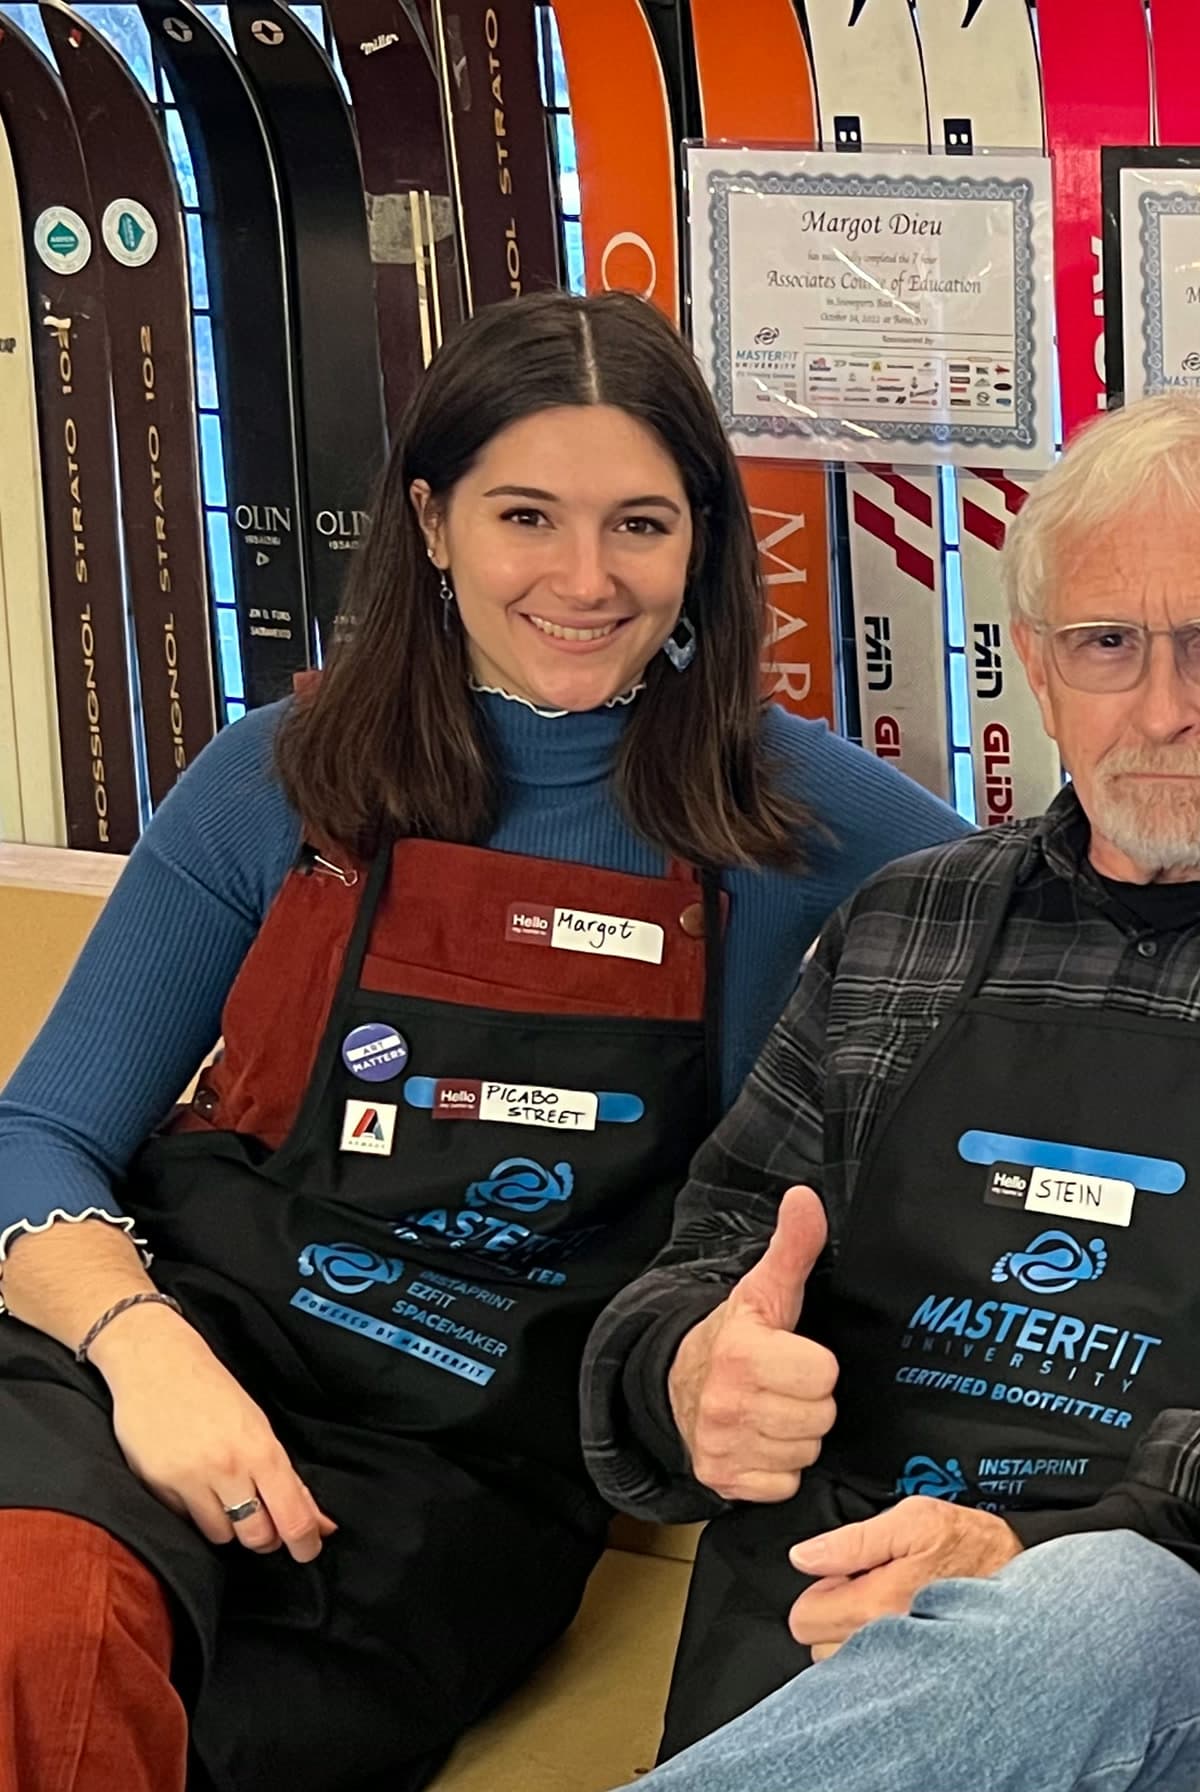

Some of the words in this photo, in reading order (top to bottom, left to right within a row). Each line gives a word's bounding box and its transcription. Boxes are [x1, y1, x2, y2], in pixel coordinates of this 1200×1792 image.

[485, 8, 512, 195] STRATO
[801, 211, 882, 241] Margot
[889, 213, 943, 235] Dieu
[767, 270, 836, 289] Associates
[891, 270, 907, 296] of
[909, 270, 981, 294] Education
[141, 325, 155, 400] 102
[735, 350, 798, 361] MASTERFIT
[65, 418, 88, 584] STRATO
[149, 425, 171, 593] STRATO
[235, 504, 291, 532] OLIN
[164, 613, 185, 783] SIGNOL
[80, 604, 109, 843] ROSSIGNOL
[512, 914, 548, 929] Hello
[557, 912, 637, 948] Margot
[352, 1048, 406, 1072] MATTERS
[363, 1041, 384, 1055] ART
[441, 1090, 476, 1103] Hello
[487, 1085, 559, 1104] PICABO
[507, 1107, 586, 1125] STREET
[993, 1172, 1027, 1190] Hello
[1035, 1179, 1102, 1206] STEIN
[406, 1281, 456, 1309] EZFIT
[419, 1270, 518, 1312] INSTAPRINT
[392, 1300, 508, 1358] SPACEMAKER
[908, 1295, 1161, 1375] MASTERFIT
[400, 1335, 485, 1379] MASTERFIT
[902, 1334, 1133, 1393] UNIVERSITY
[896, 1367, 987, 1397] CERTIFIED
[991, 1384, 1133, 1429] BOOTFITTER
[978, 1458, 1089, 1476] INSTAPRINT
